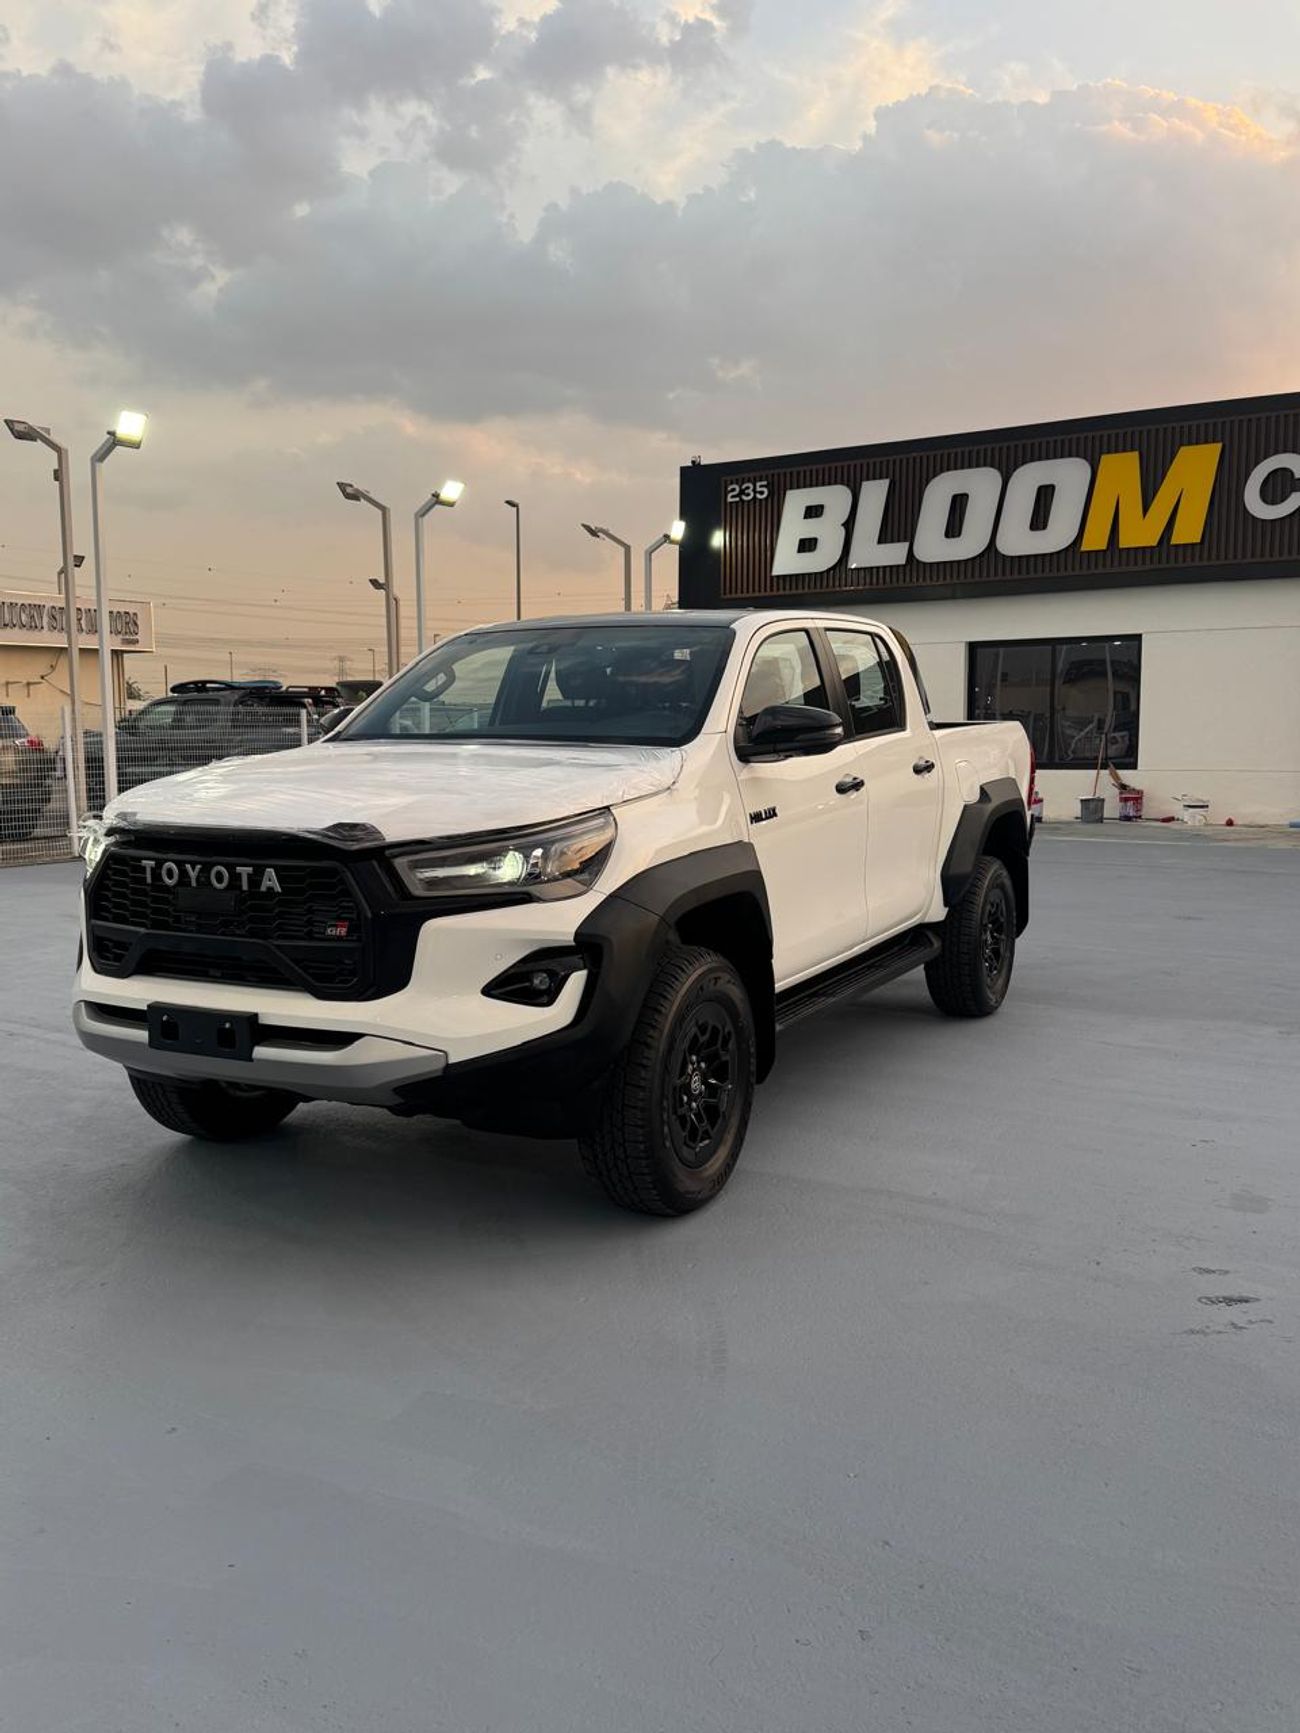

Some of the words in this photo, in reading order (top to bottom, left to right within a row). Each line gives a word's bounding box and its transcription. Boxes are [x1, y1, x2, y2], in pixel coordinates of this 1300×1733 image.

[727, 480, 769, 502] 235
[771, 442, 1222, 577] BLOOM
[1243, 452, 1300, 520] C
[0, 600, 46, 631] LUCKY
[48, 604, 84, 633] STR
[84, 608, 139, 636] MTORS
[748, 805, 778, 825] HILUX
[141, 859, 282, 893] TOYOTA
